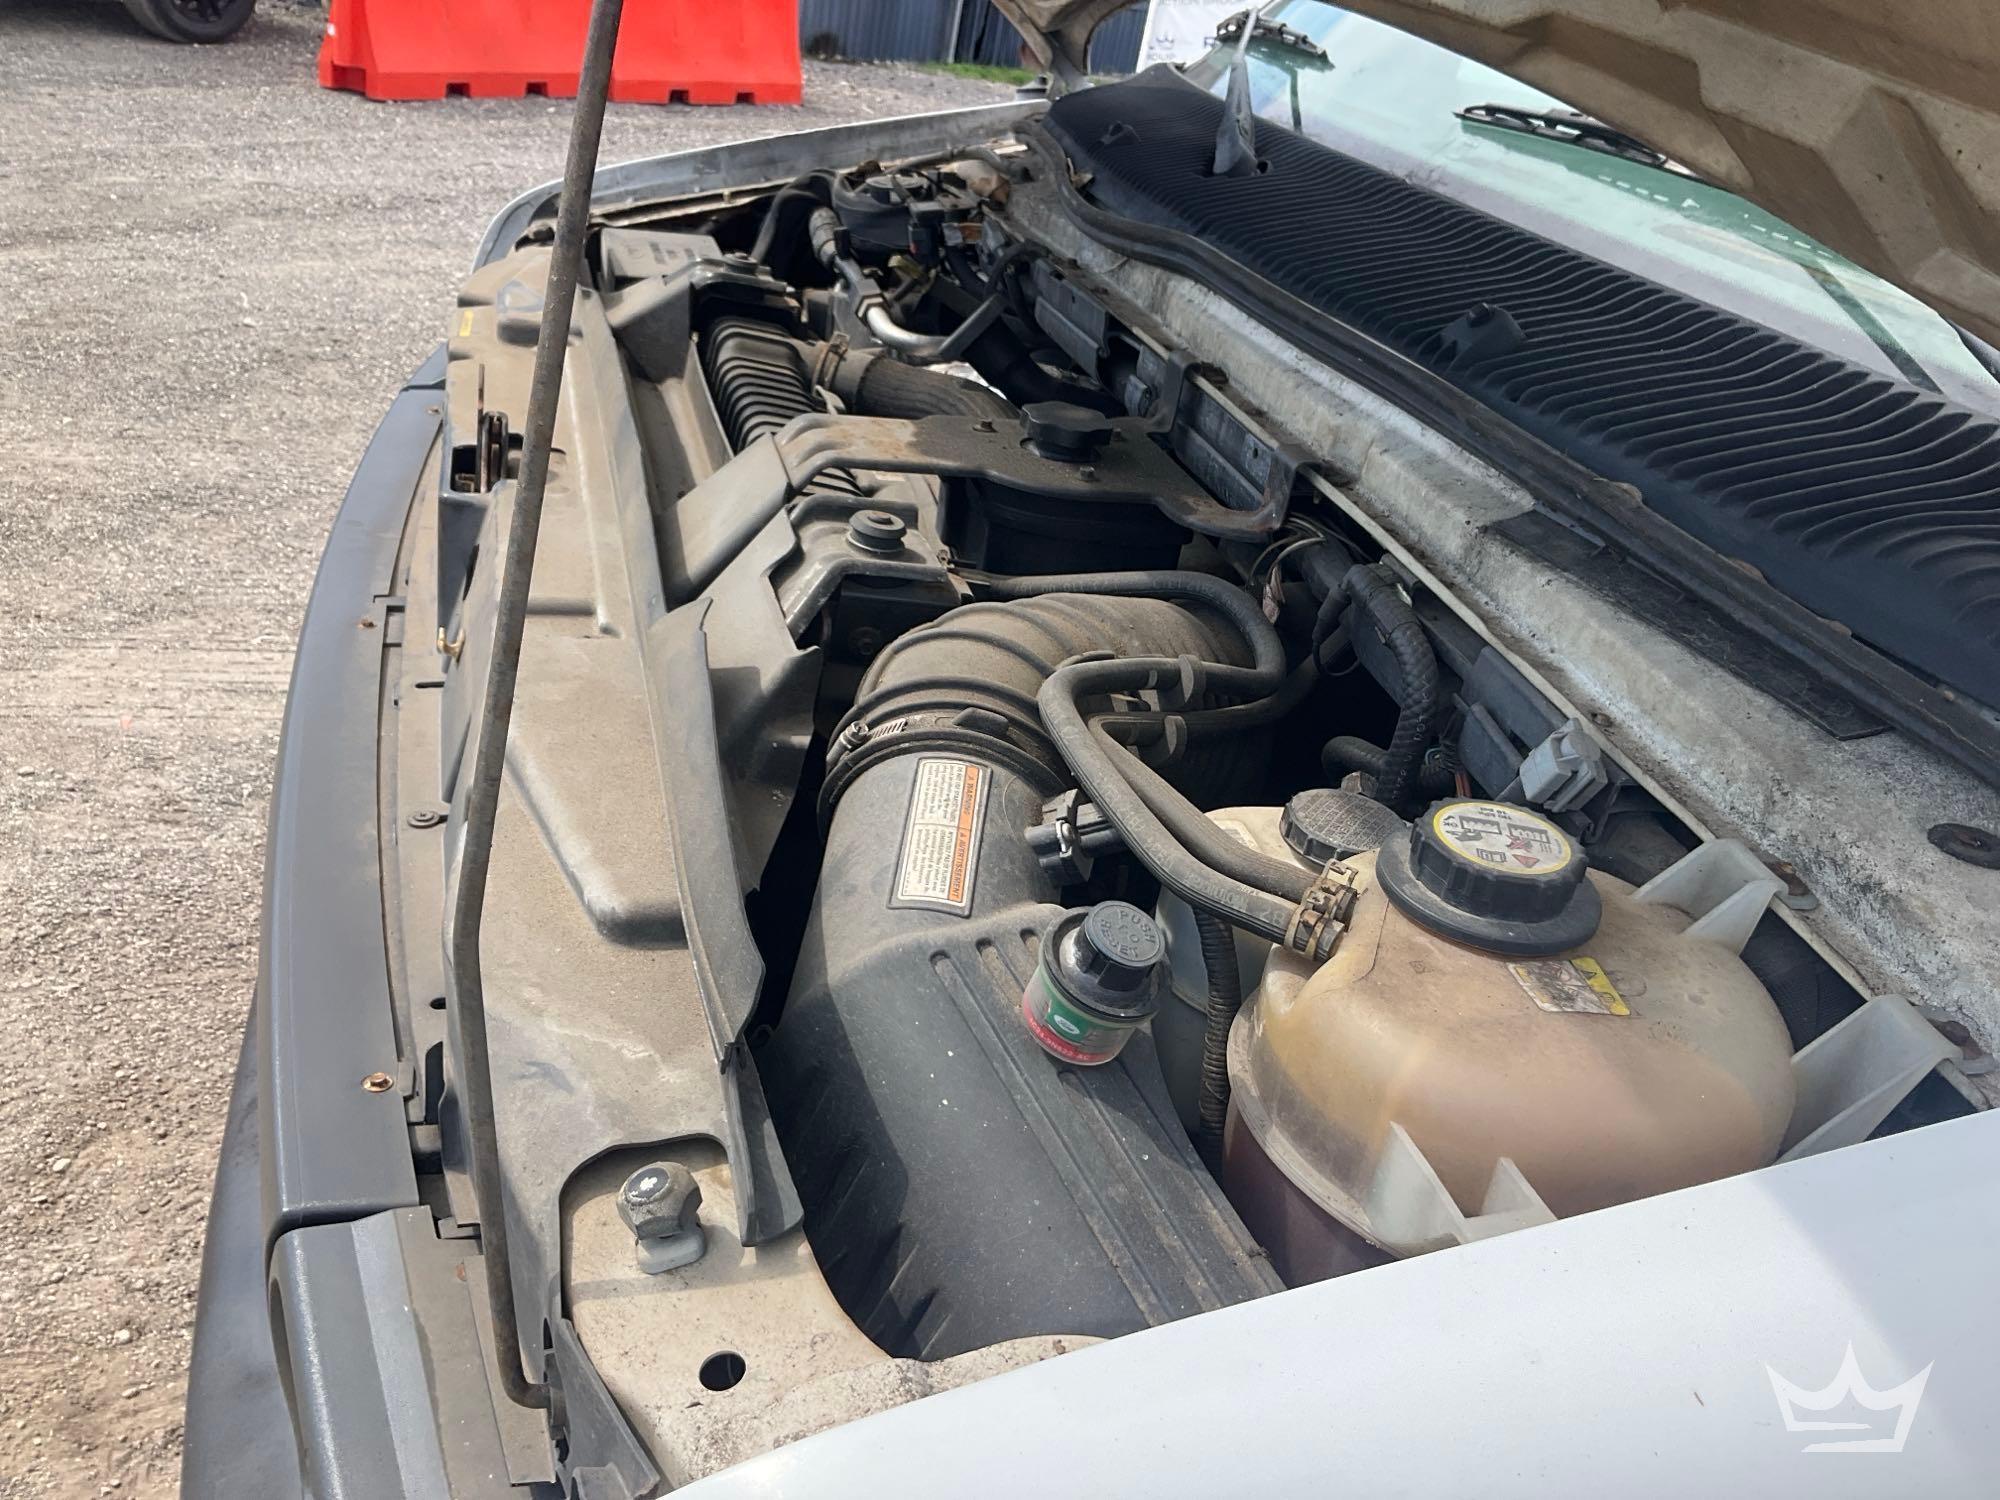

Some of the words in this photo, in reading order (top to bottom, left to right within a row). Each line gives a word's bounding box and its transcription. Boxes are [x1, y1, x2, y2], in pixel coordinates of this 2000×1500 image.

[950, 839, 966, 898] AVERTISSEMENT
[1100, 918, 1139, 959] RESET
[1119, 909, 1157, 945] PUSH
